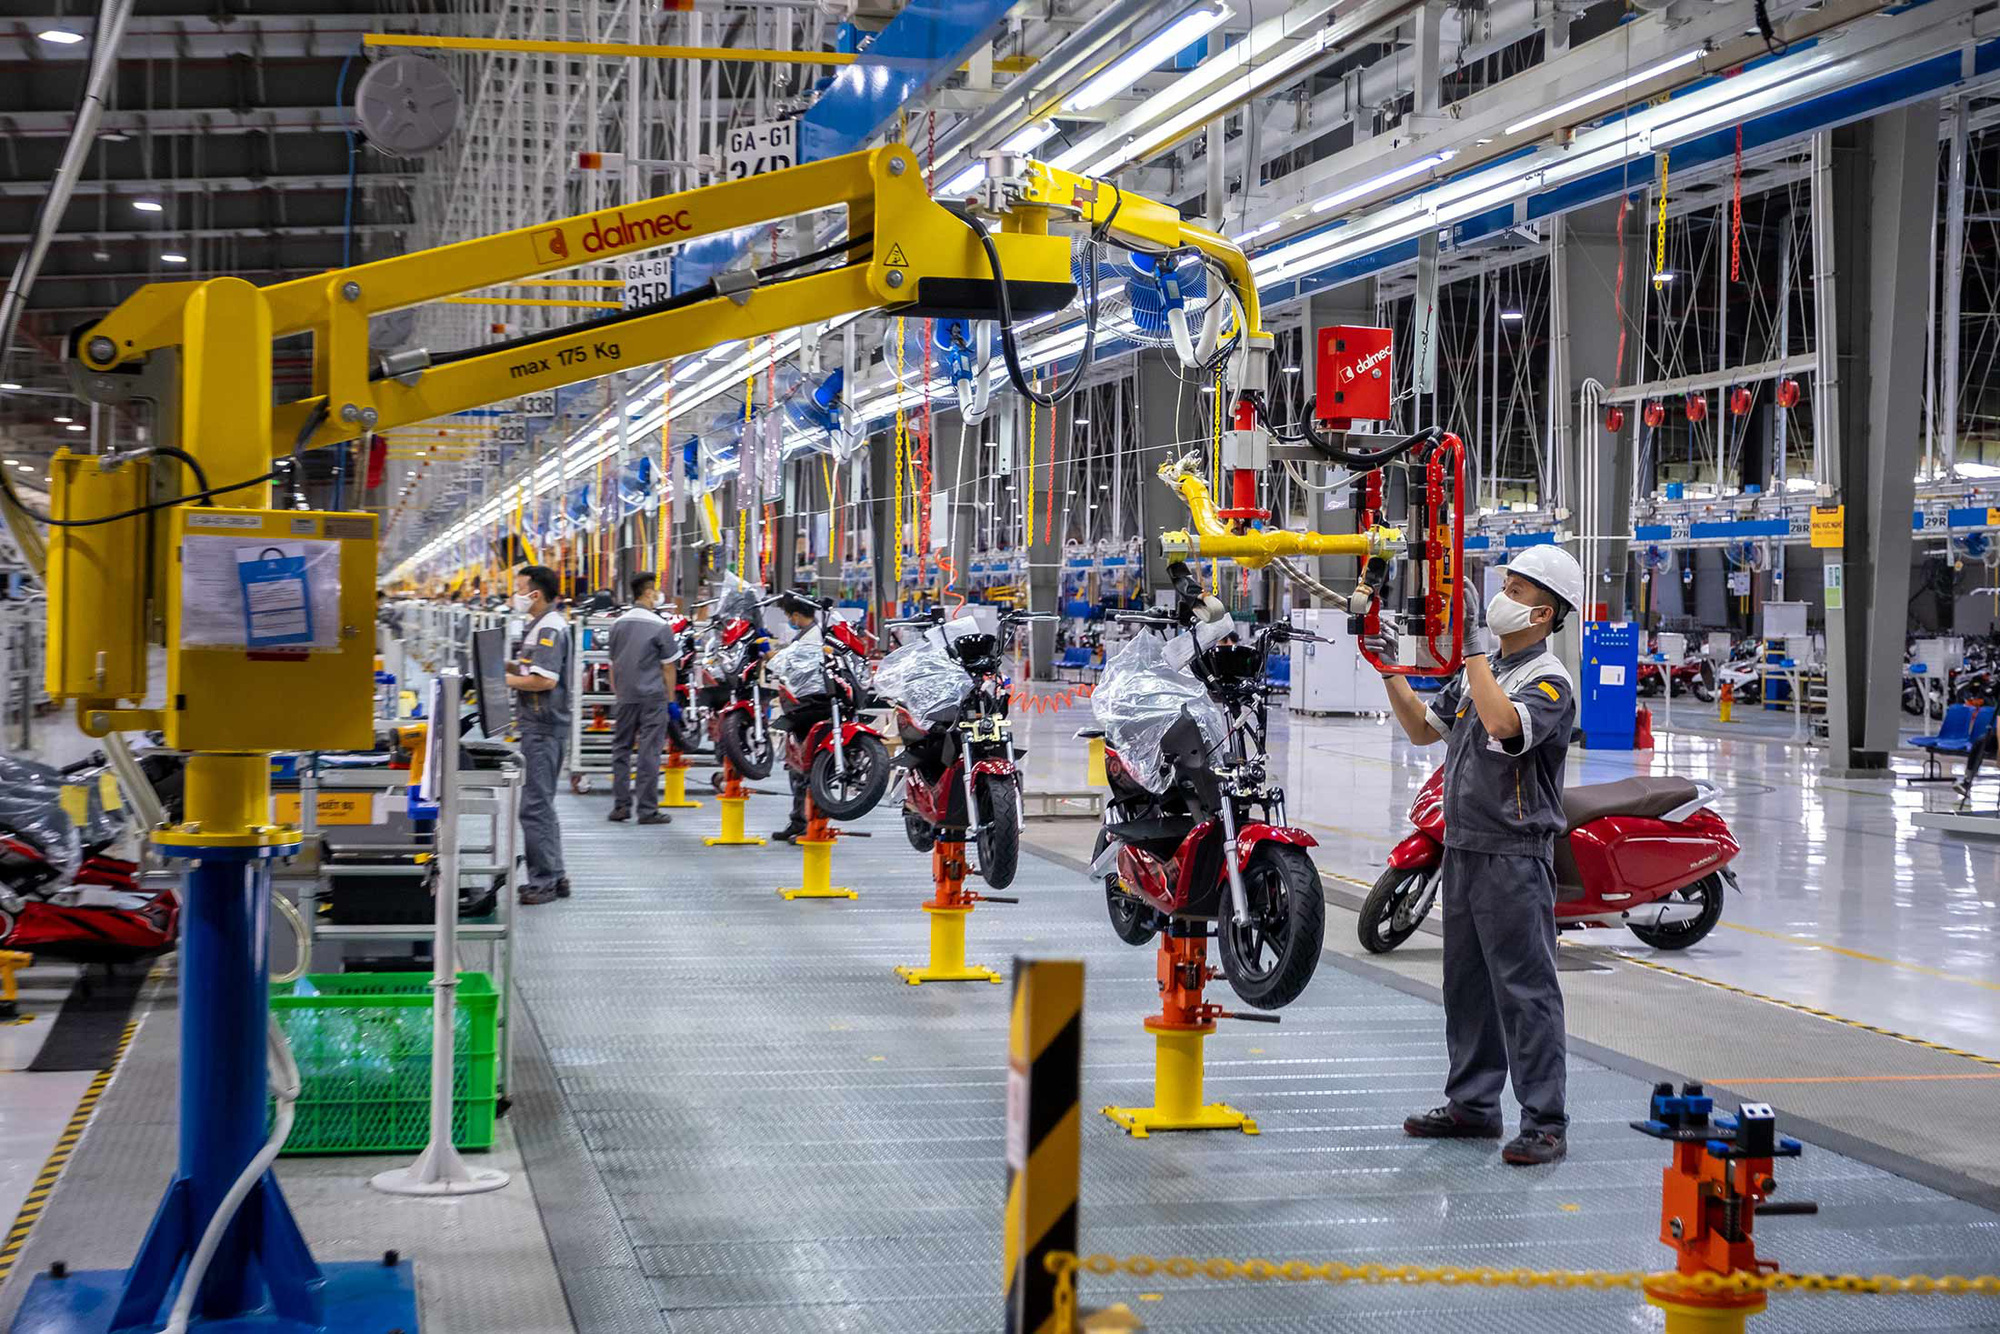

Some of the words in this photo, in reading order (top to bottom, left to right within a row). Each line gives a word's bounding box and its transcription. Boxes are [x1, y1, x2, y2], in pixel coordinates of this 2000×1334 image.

[731, 125, 790, 153] GA-G1
[582, 210, 693, 253] dalmec
[628, 260, 668, 280] GA-G1
[628, 282, 667, 309] 35R
[509, 358, 551, 378] max
[556, 346, 588, 366] 175
[594, 342, 621, 360] Kg
[1356, 345, 1392, 374] dalmec
[526, 396, 553, 413] 33R
[500, 426, 525, 441] 32R
[1790, 524, 1810, 533] 28R
[1925, 517, 1947, 527] 29R
[1672, 530, 1689, 538] 27R
